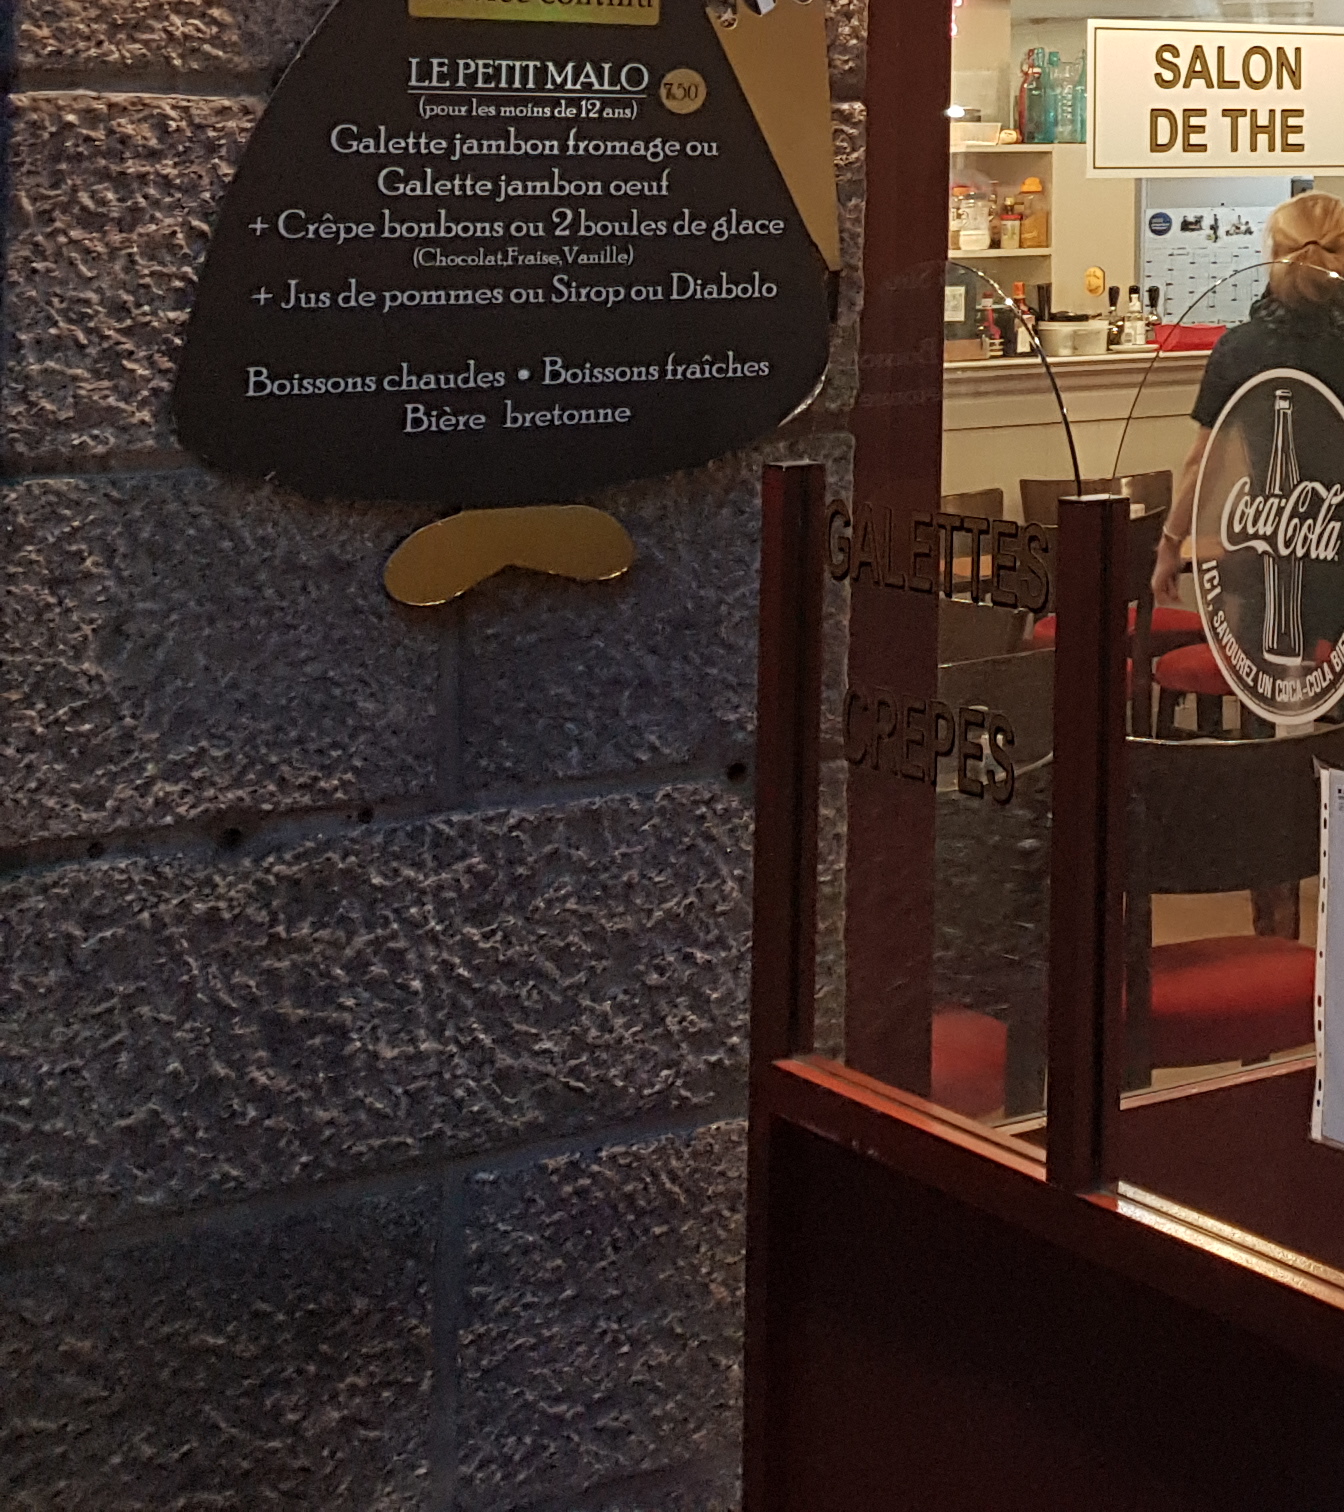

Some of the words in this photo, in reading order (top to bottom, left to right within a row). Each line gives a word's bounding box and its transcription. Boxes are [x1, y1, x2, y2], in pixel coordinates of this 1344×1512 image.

[407, 57, 450, 88] LE
[455, 58, 543, 90] PETIT
[545, 62, 649, 91] MALO
[1153, 43, 1302, 90] SALON
[418, 96, 468, 120] (pour
[471, 97, 496, 117] les
[499, 100, 552, 119] moins
[554, 100, 577, 119] de
[580, 99, 599, 118] 12
[602, 100, 639, 120] ans)
[327, 123, 448, 156] Galette
[451, 127, 559, 161] jambon
[565, 127, 681, 163] fromage
[685, 139, 719, 157] ou
[1149, 108, 1208, 153] DE
[1222, 108, 1305, 153] THE
[377, 167, 492, 197] Galette
[496, 168, 603, 203] jambon
[608, 168, 671, 197] oeuf
[277, 209, 375, 246] Crêpe
[380, 209, 505, 240] bonbons
[510, 218, 545, 238] ou
[551, 207, 574, 237] 2
[578, 208, 668, 239] boules
[672, 209, 705, 237] de
[711, 207, 786, 242] glace
[281, 278, 332, 311] Jus
[337, 279, 376, 310] de
[382, 285, 504, 314] pommes
[509, 285, 545, 304] ou
[550, 274, 625, 308] Sirop
[630, 282, 664, 303] ou
[670, 271, 778, 301] Diabolo
[245, 366, 377, 398] Boissons
[382, 359, 506, 391] chaudes
[542, 355, 659, 386] Boissons
[664, 350, 770, 379] fraîches
[403, 402, 486, 434] Bière
[503, 399, 631, 430] bretonne
[826, 497, 1050, 614] GALETTES
[1212, 613, 1254, 688] SAVOUREZ
[1257, 670, 1274, 695] UN
[1274, 666, 1334, 703] COCA-COLA
